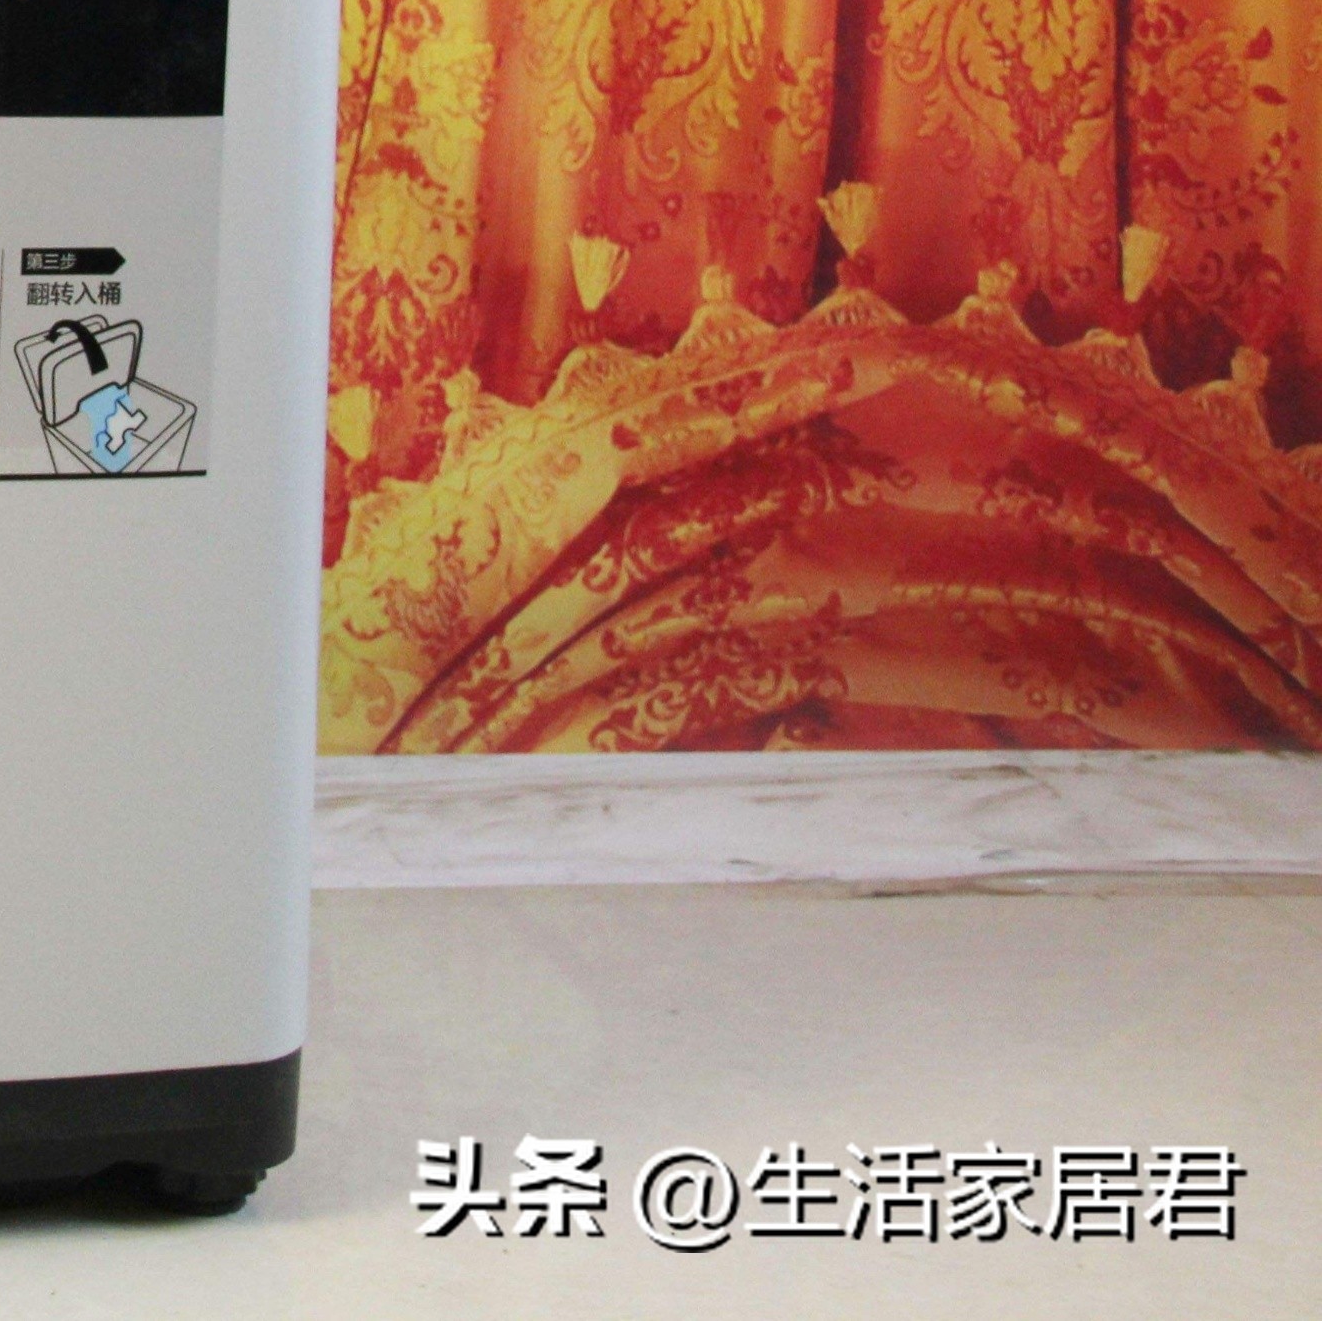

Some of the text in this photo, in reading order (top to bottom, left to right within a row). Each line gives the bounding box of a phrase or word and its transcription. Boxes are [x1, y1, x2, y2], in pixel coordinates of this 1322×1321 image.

[26, 252, 77, 271] 第三步
[26, 281, 123, 307] 翻转入桶
